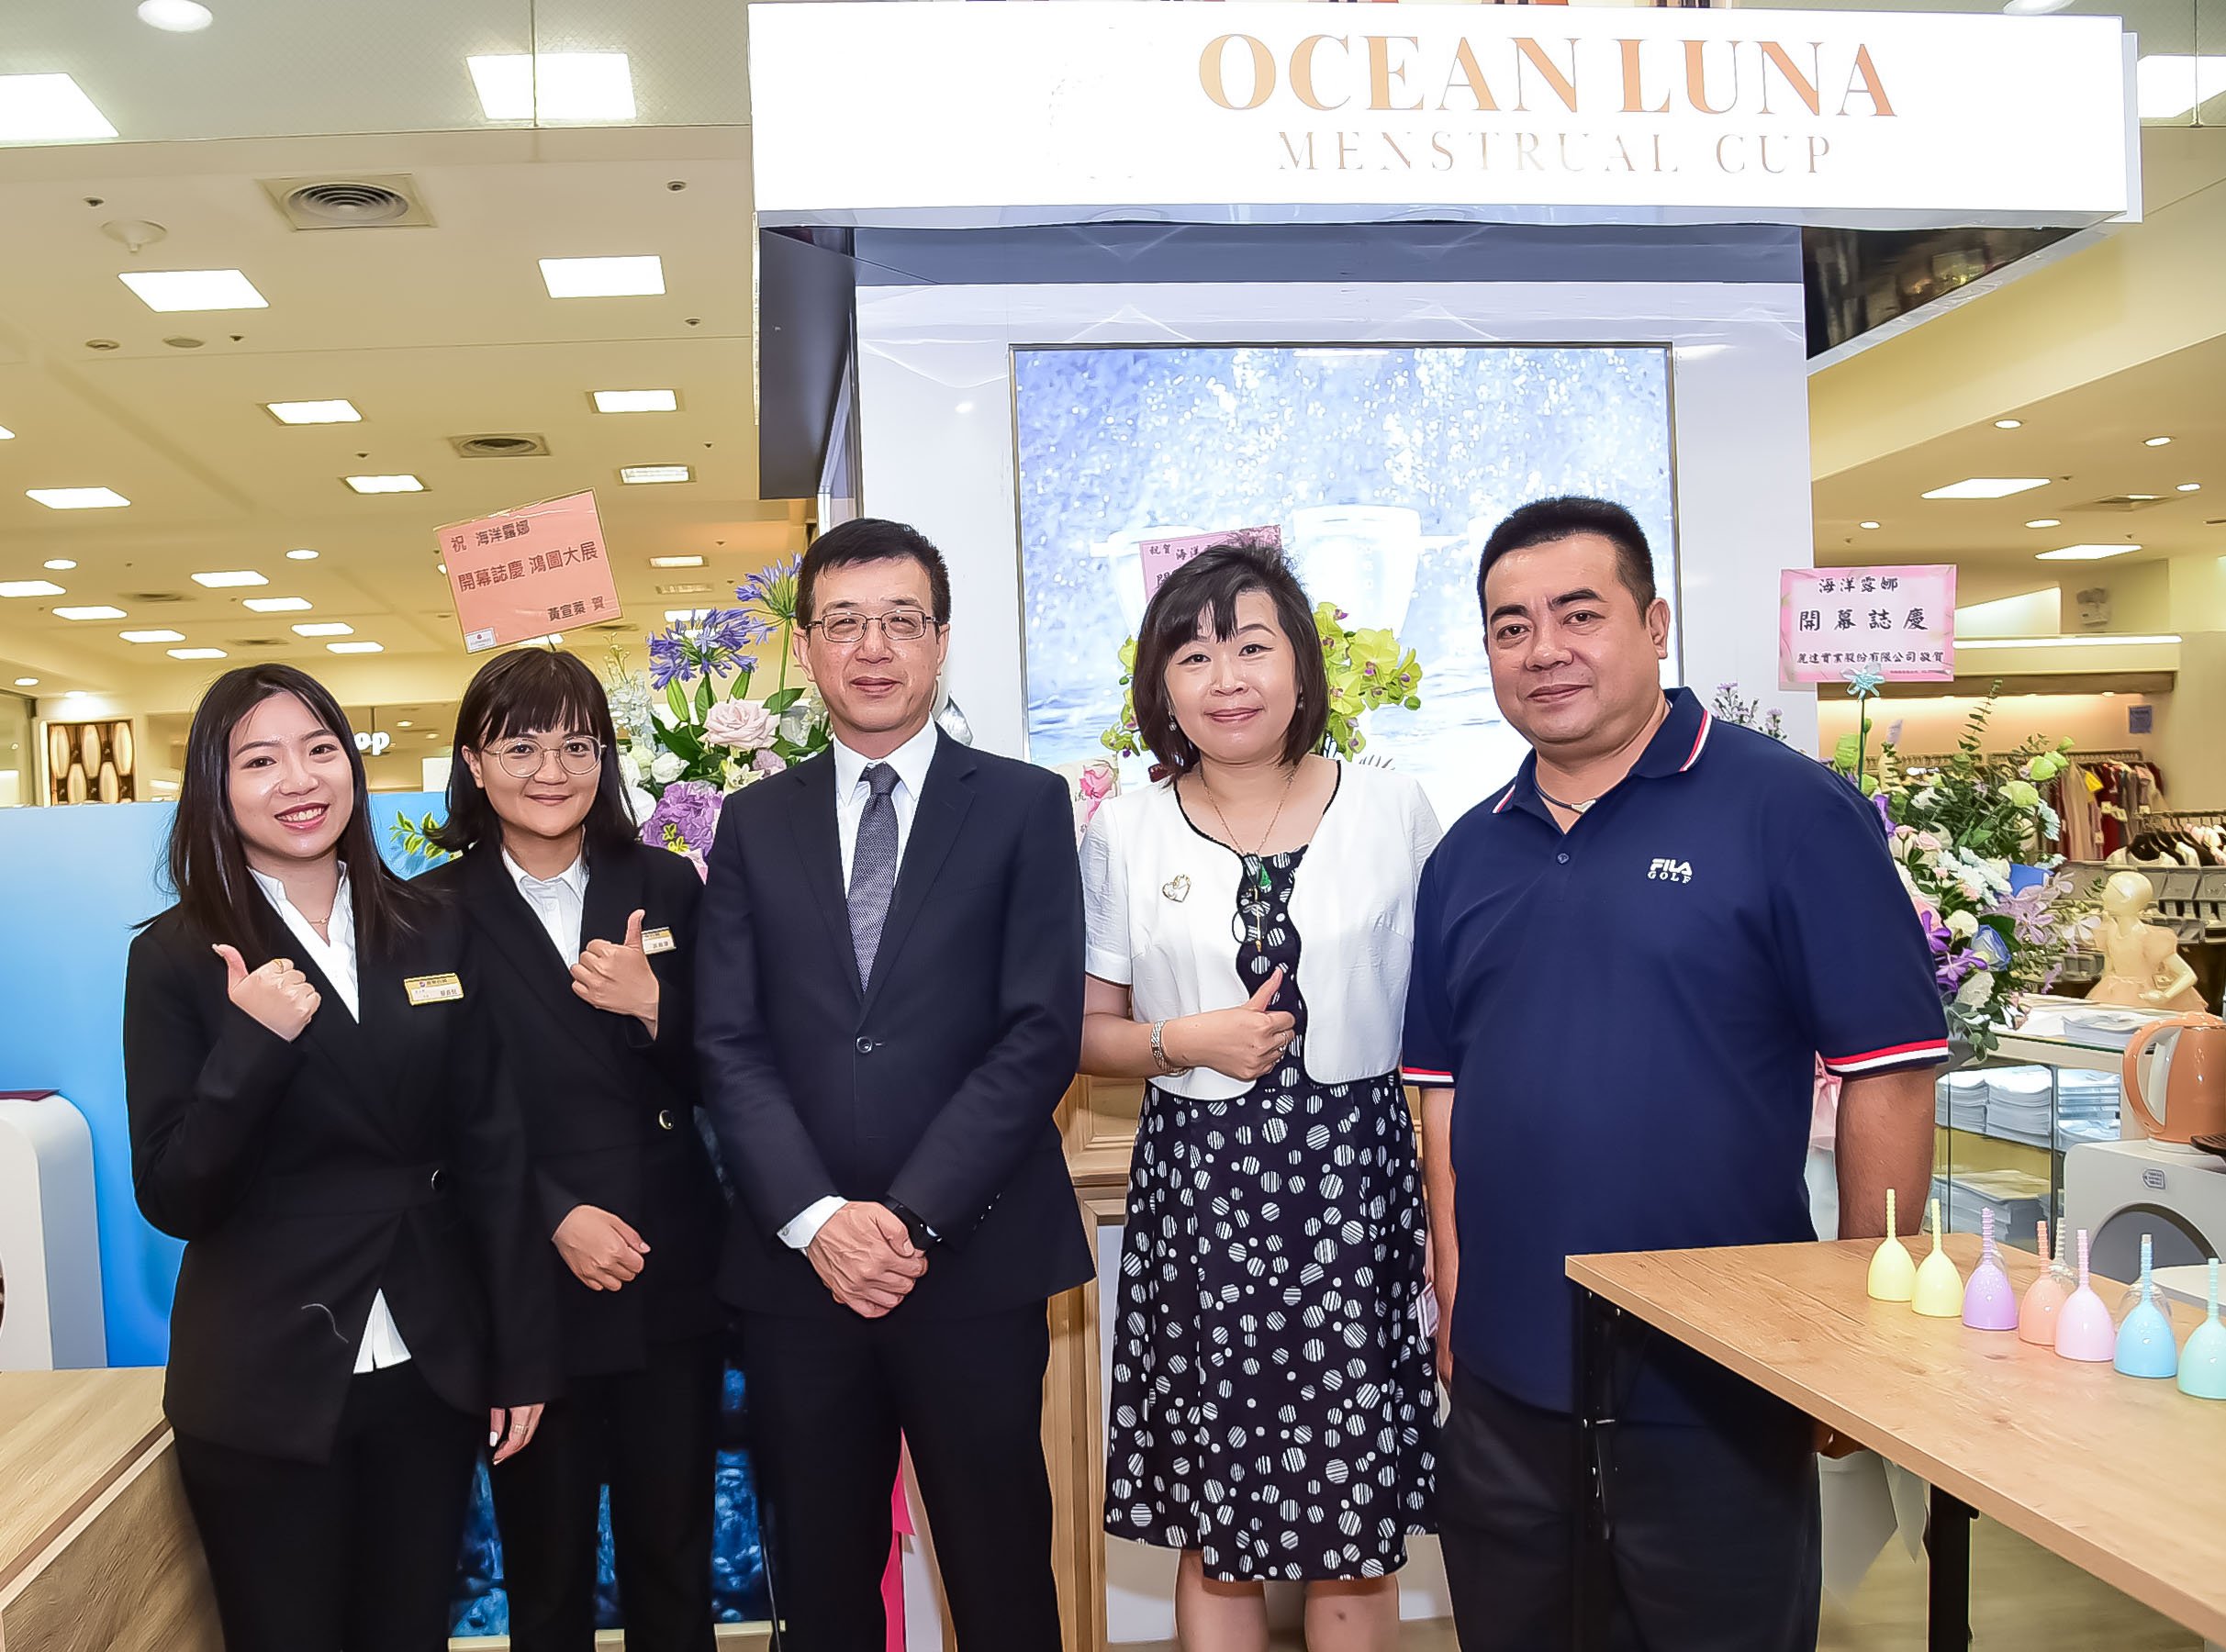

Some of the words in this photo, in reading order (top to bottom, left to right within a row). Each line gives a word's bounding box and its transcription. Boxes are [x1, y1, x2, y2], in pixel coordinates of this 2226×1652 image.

[1199, 33, 1582, 112] OCEAN
[1612, 38, 1897, 117] LUNA
[1279, 130, 1678, 172] MENSTRUAL
[1716, 134, 1829, 173] CUP
[451, 535, 467, 553] 祝
[475, 519, 531, 547] 海洋露娜
[457, 559, 526, 593] 開幕誌慶
[528, 541, 598, 575] 鴻圖大展
[1818, 575, 1899, 594] 海洋露娜
[591, 596, 606, 611] 賀
[1799, 608, 1929, 632] 開幕誌慶
[1648, 871, 1691, 884] GOLF
[1650, 858, 1693, 876] FILA
